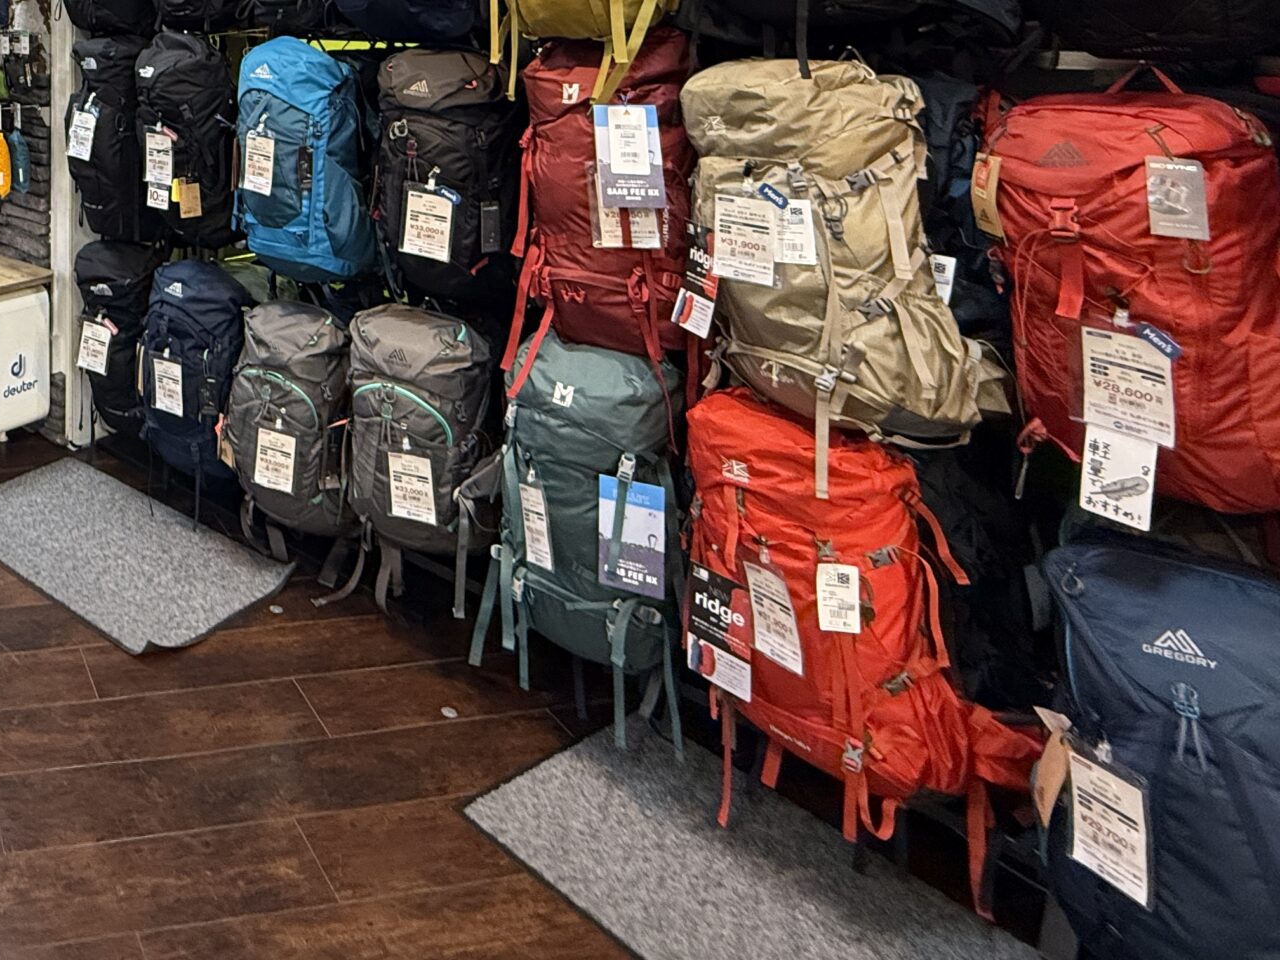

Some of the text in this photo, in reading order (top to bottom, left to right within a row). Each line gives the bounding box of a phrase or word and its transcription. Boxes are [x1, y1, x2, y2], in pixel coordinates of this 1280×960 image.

[410, 224, 440, 234] ¥33,000
[721, 237, 760, 251] ¥31,900
[689, 246, 713, 270] ridg
[1142, 327, 1174, 354] Men's
[3, 379, 39, 399] deuter
[1093, 378, 1153, 403] ¥28,600
[694, 591, 746, 627] ridge
[1141, 643, 1218, 670] GREGORY
